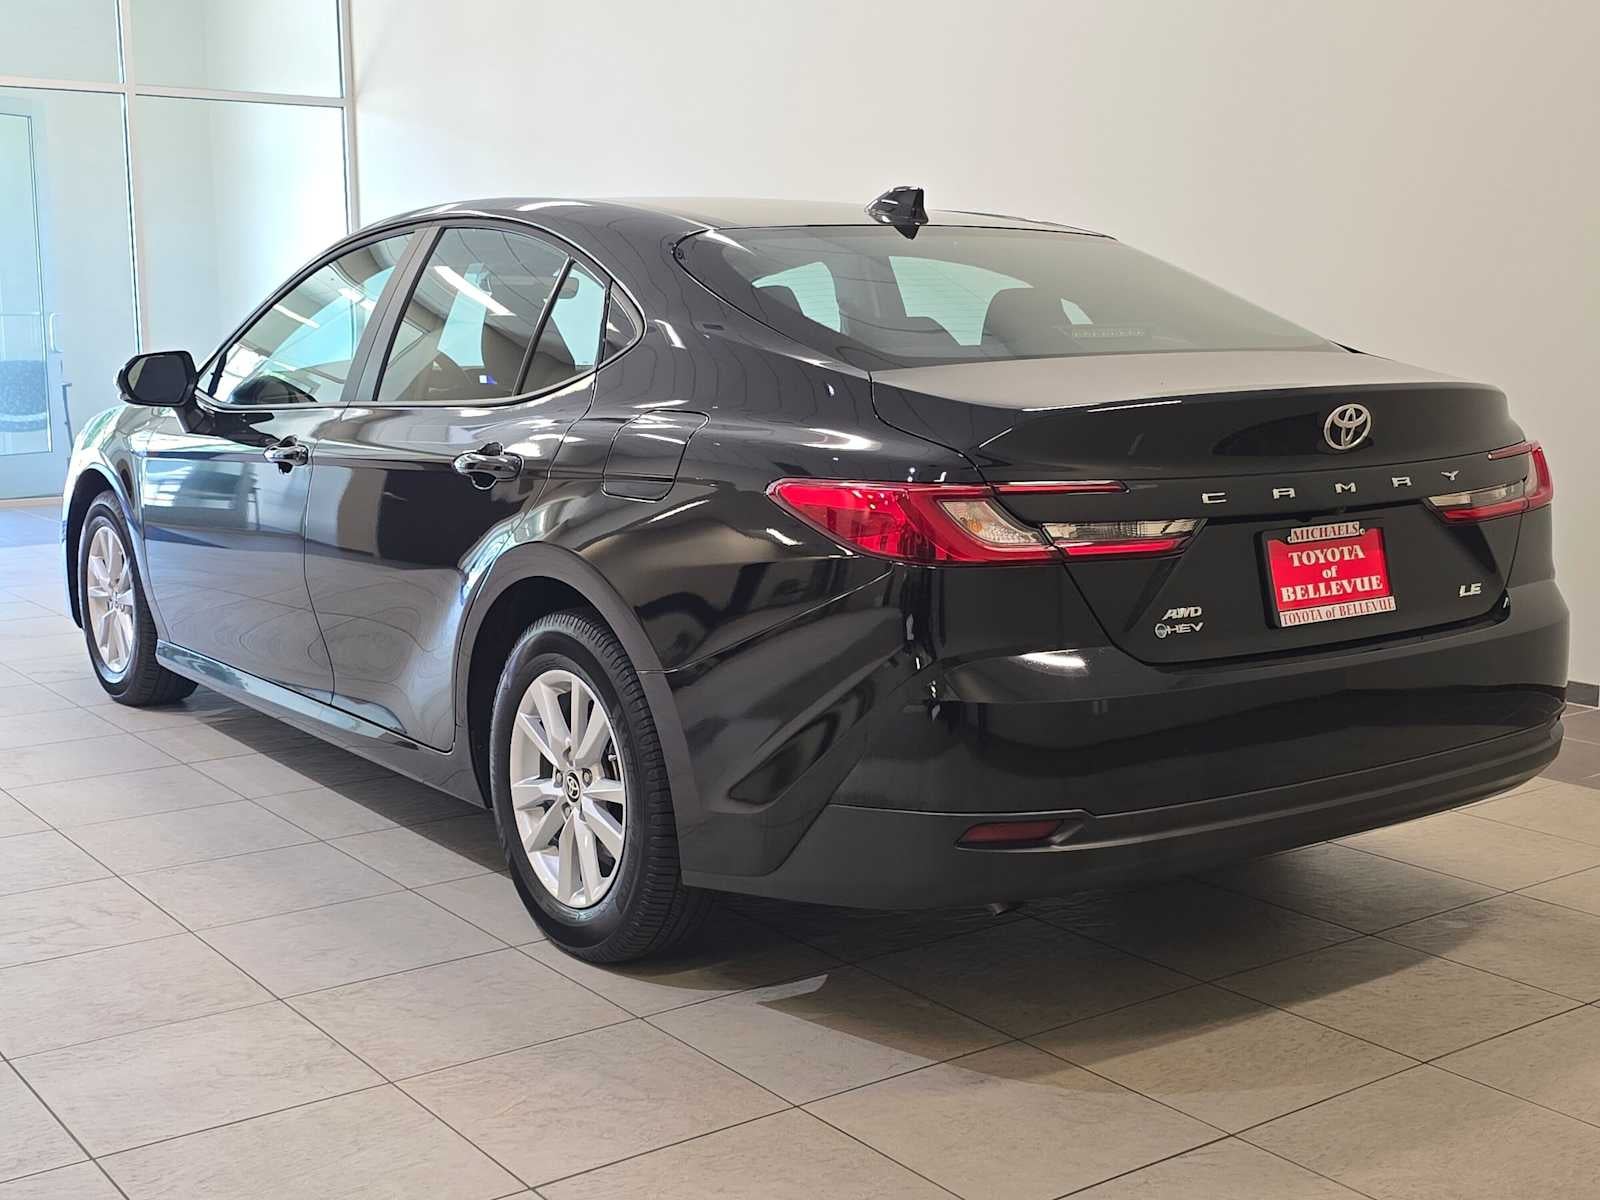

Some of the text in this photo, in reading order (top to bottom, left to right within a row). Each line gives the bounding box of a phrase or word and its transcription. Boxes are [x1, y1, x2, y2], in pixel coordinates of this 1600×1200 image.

[1202, 470, 1459, 504] CAMRY
[1292, 523, 1358, 541] MICHAELS
[1288, 545, 1365, 567] TOYOTA
[1322, 566, 1338, 578] of
[1280, 575, 1383, 602] BELLEVUE
[1459, 582, 1482, 597] LE
[1161, 606, 1202, 620] AWD
[1282, 599, 1394, 625] TOYOTA of BELLEVUE
[1166, 622, 1204, 635] HEV
